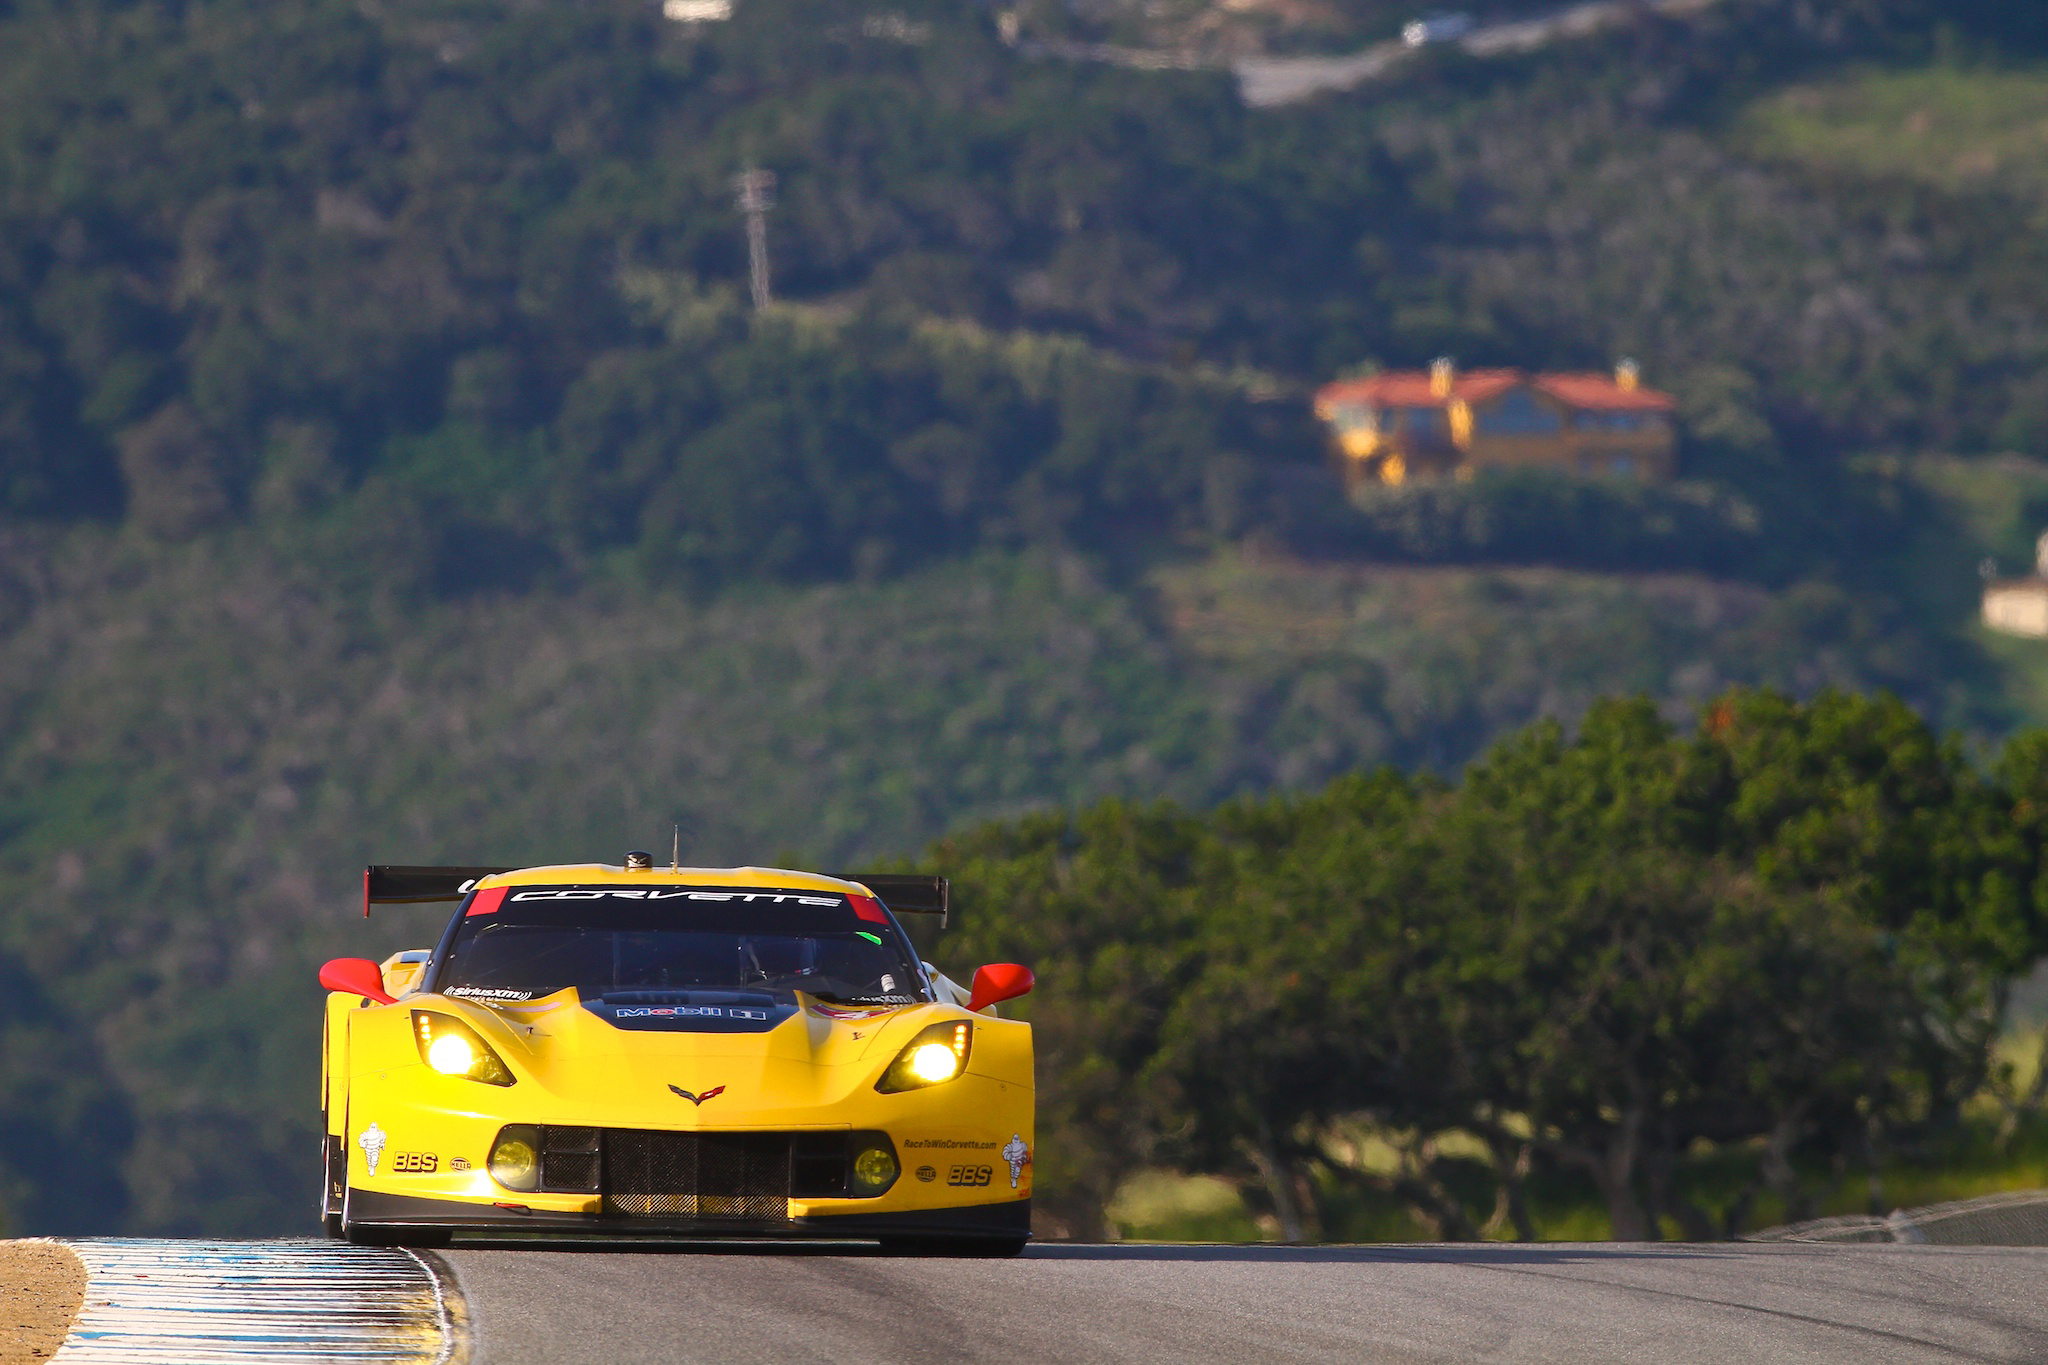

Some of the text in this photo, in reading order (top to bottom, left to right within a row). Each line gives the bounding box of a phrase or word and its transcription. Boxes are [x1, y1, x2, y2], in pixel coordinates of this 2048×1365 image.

[510, 890, 842, 907] CORVETTE
[616, 1007, 721, 1018] Mobil
[904, 1139, 997, 1150] RaceToWinCorvette.com
[393, 1151, 438, 1173] BBS
[946, 1165, 993, 1187] BBS
